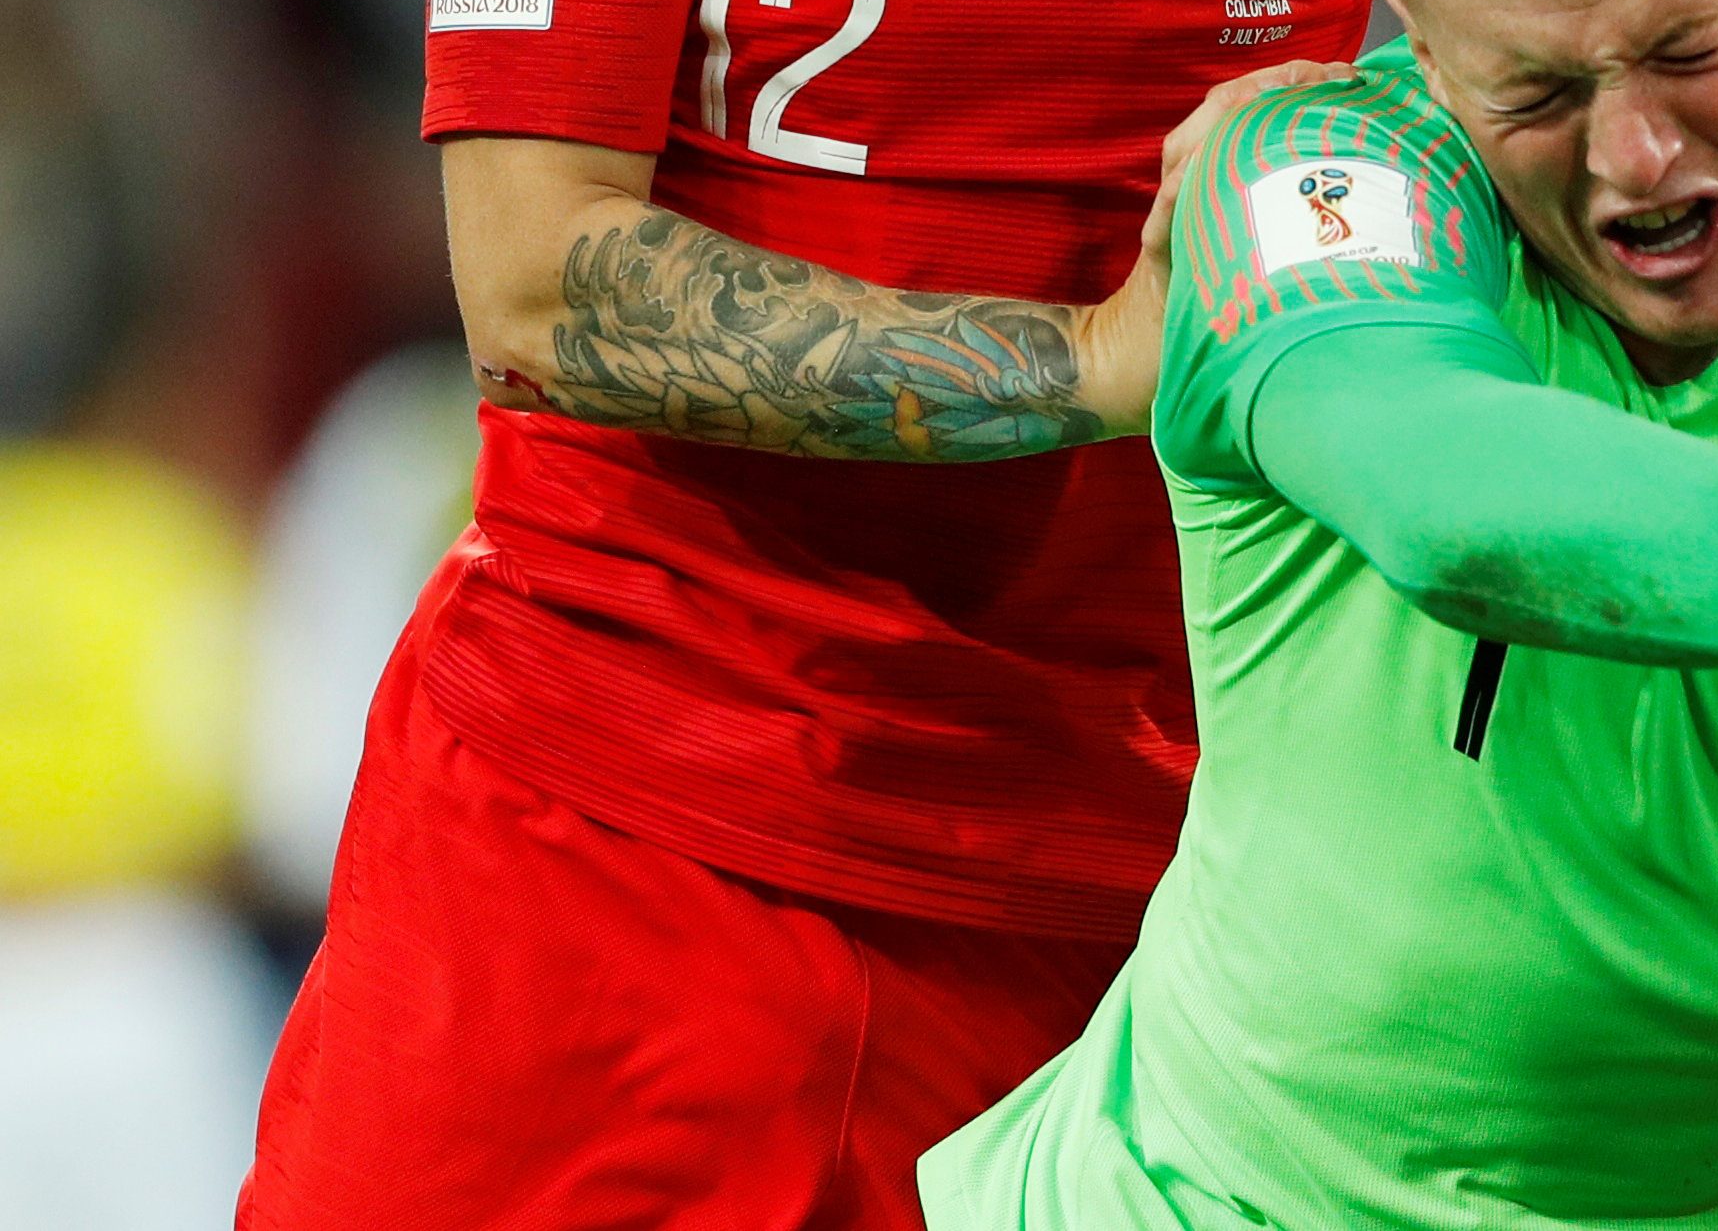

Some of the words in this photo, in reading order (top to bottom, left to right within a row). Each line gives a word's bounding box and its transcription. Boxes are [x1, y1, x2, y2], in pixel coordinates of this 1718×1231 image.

[1218, 27, 1231, 45] 3
[1231, 27, 1265, 45] JULY
[1262, 24, 1293, 43] 2018
